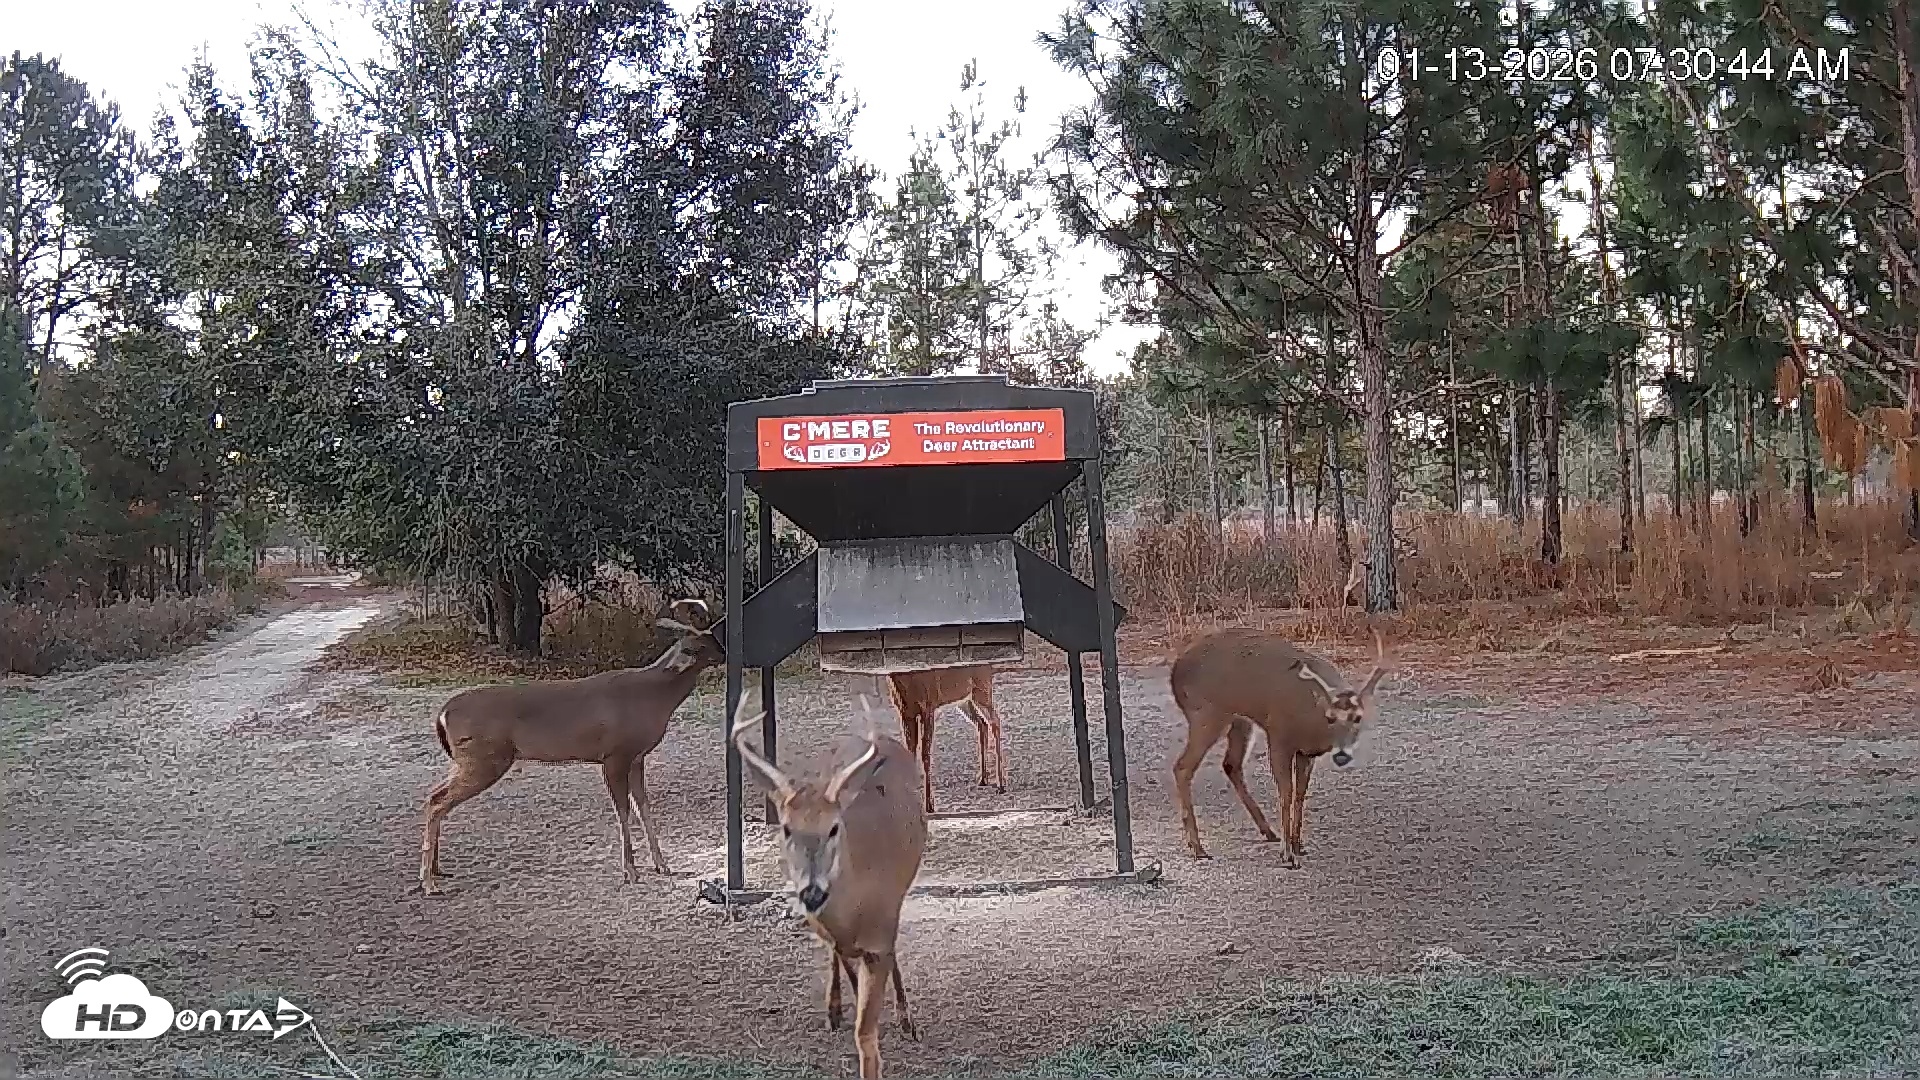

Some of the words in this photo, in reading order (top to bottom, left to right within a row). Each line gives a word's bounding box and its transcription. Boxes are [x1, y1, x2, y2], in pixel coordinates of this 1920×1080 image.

[783, 419, 891, 441] C'MERE
[945, 419, 1045, 434] Revolutionary
[961, 437, 1035, 451] Attractant
